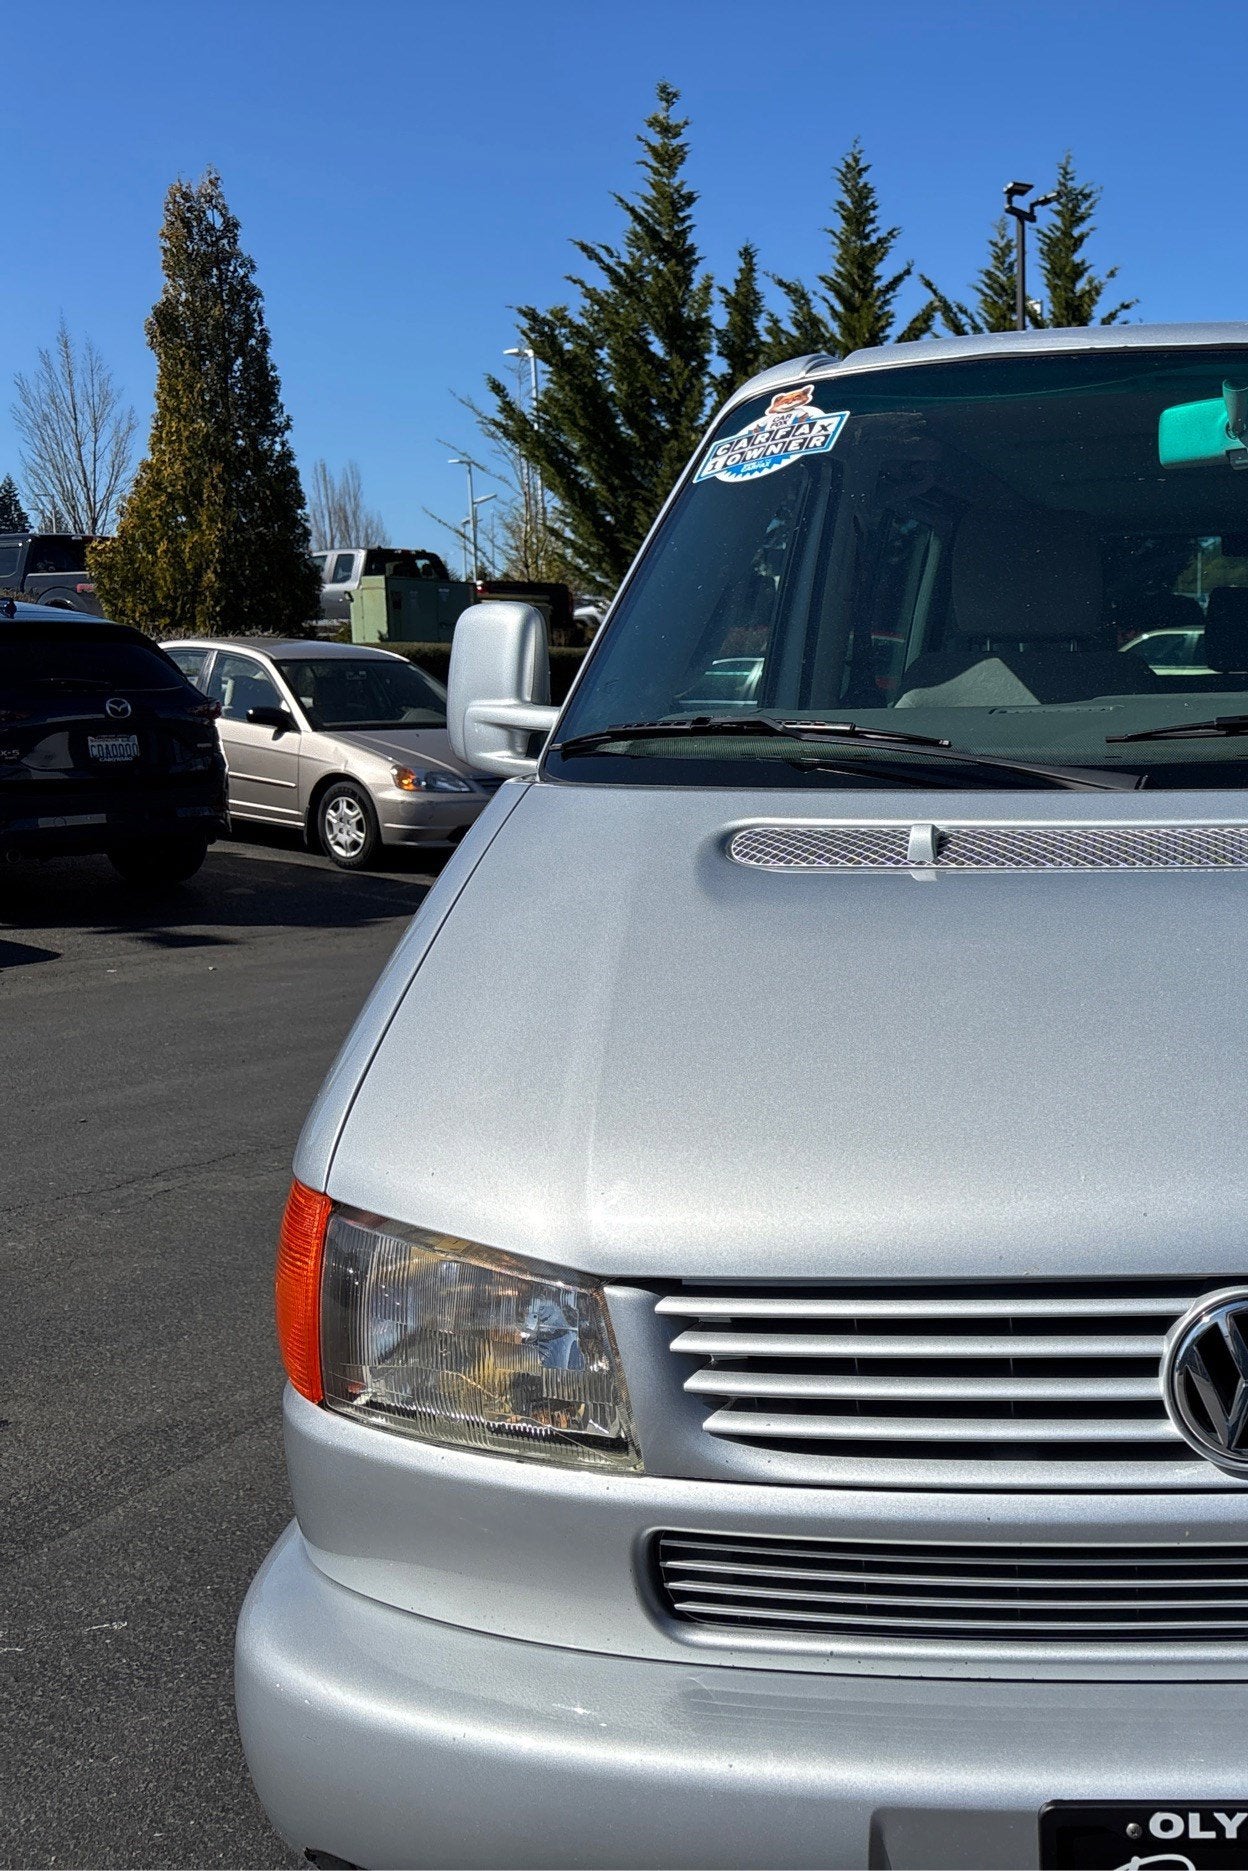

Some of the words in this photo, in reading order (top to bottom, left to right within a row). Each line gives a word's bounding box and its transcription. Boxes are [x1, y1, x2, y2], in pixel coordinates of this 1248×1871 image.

[772, 413, 792, 423] CAR
[770, 420, 788, 429] FOX
[715, 422, 834, 457] CARFAX
